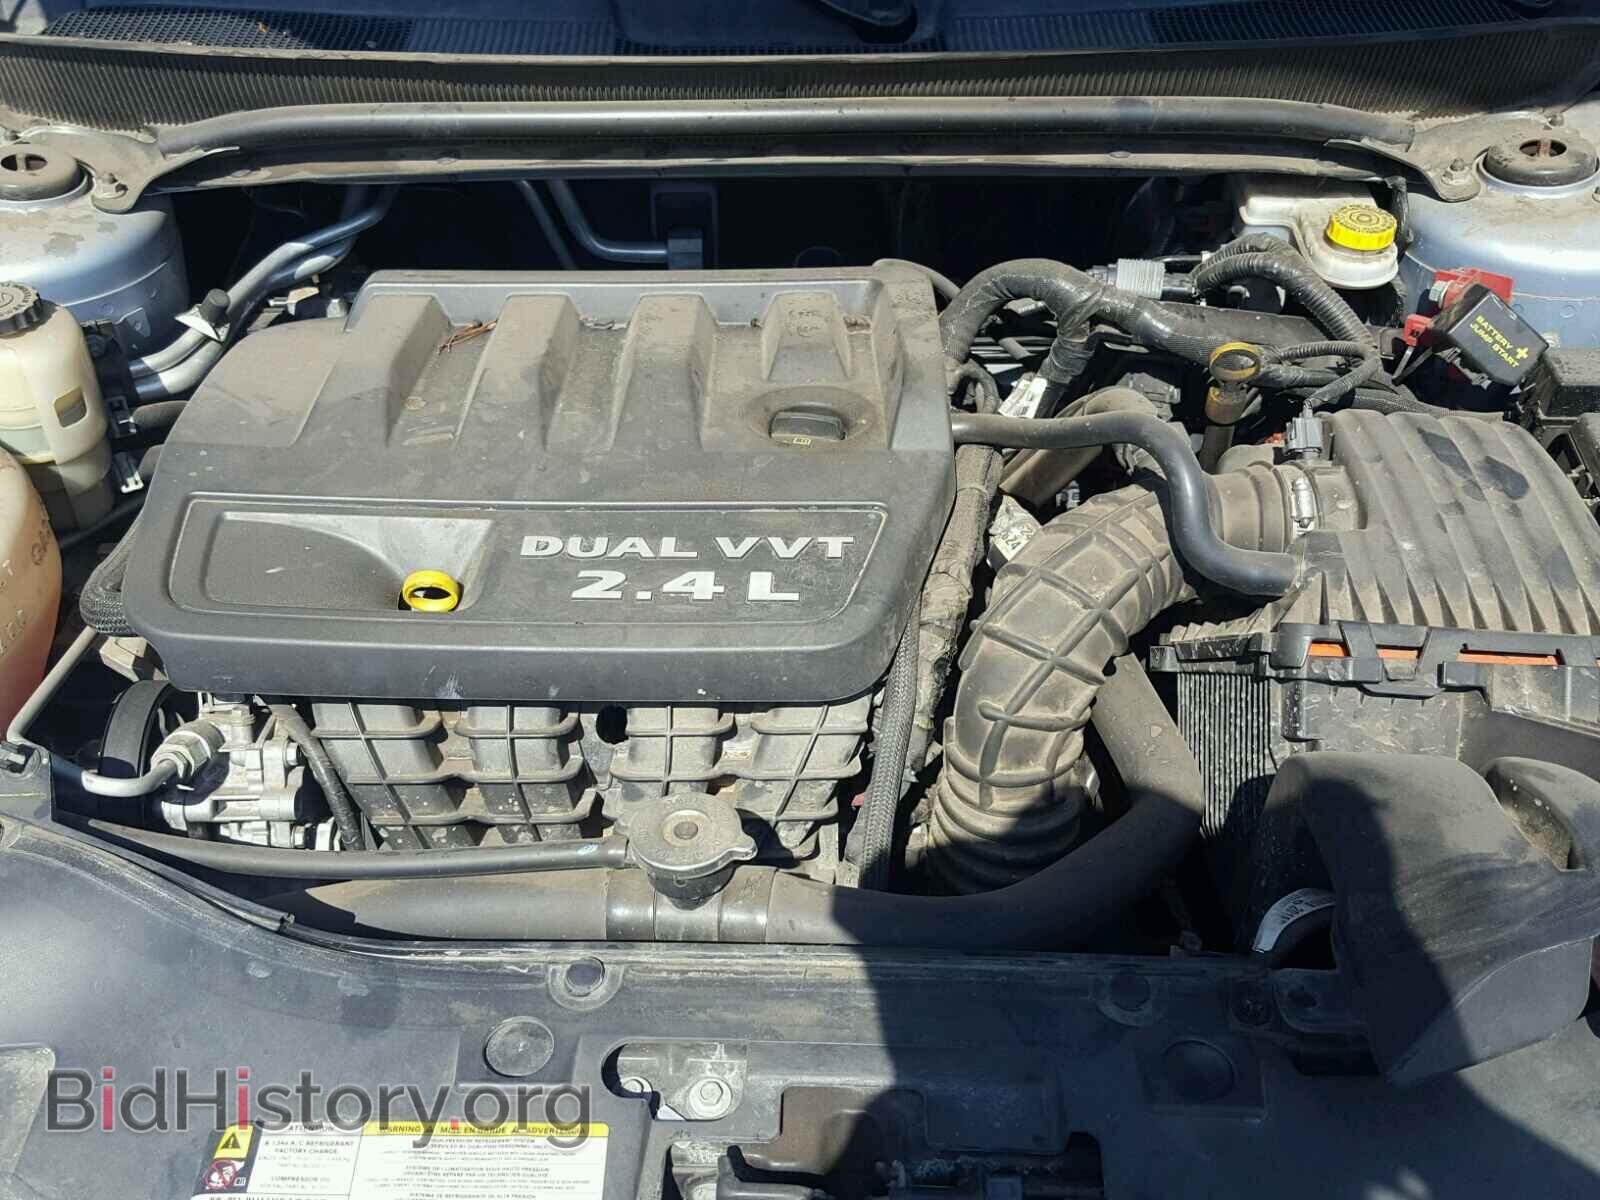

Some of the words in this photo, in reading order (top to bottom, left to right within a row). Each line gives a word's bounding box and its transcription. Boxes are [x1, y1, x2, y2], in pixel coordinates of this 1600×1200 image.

[1470, 323, 1493, 345] JUMP
[1492, 343, 1520, 368] START
[1475, 315, 1513, 349] BATTERY
[520, 535, 699, 558] DUAL
[714, 535, 856, 559] VVT
[571, 569, 726, 601] 2.4
[747, 571, 801, 601] L
